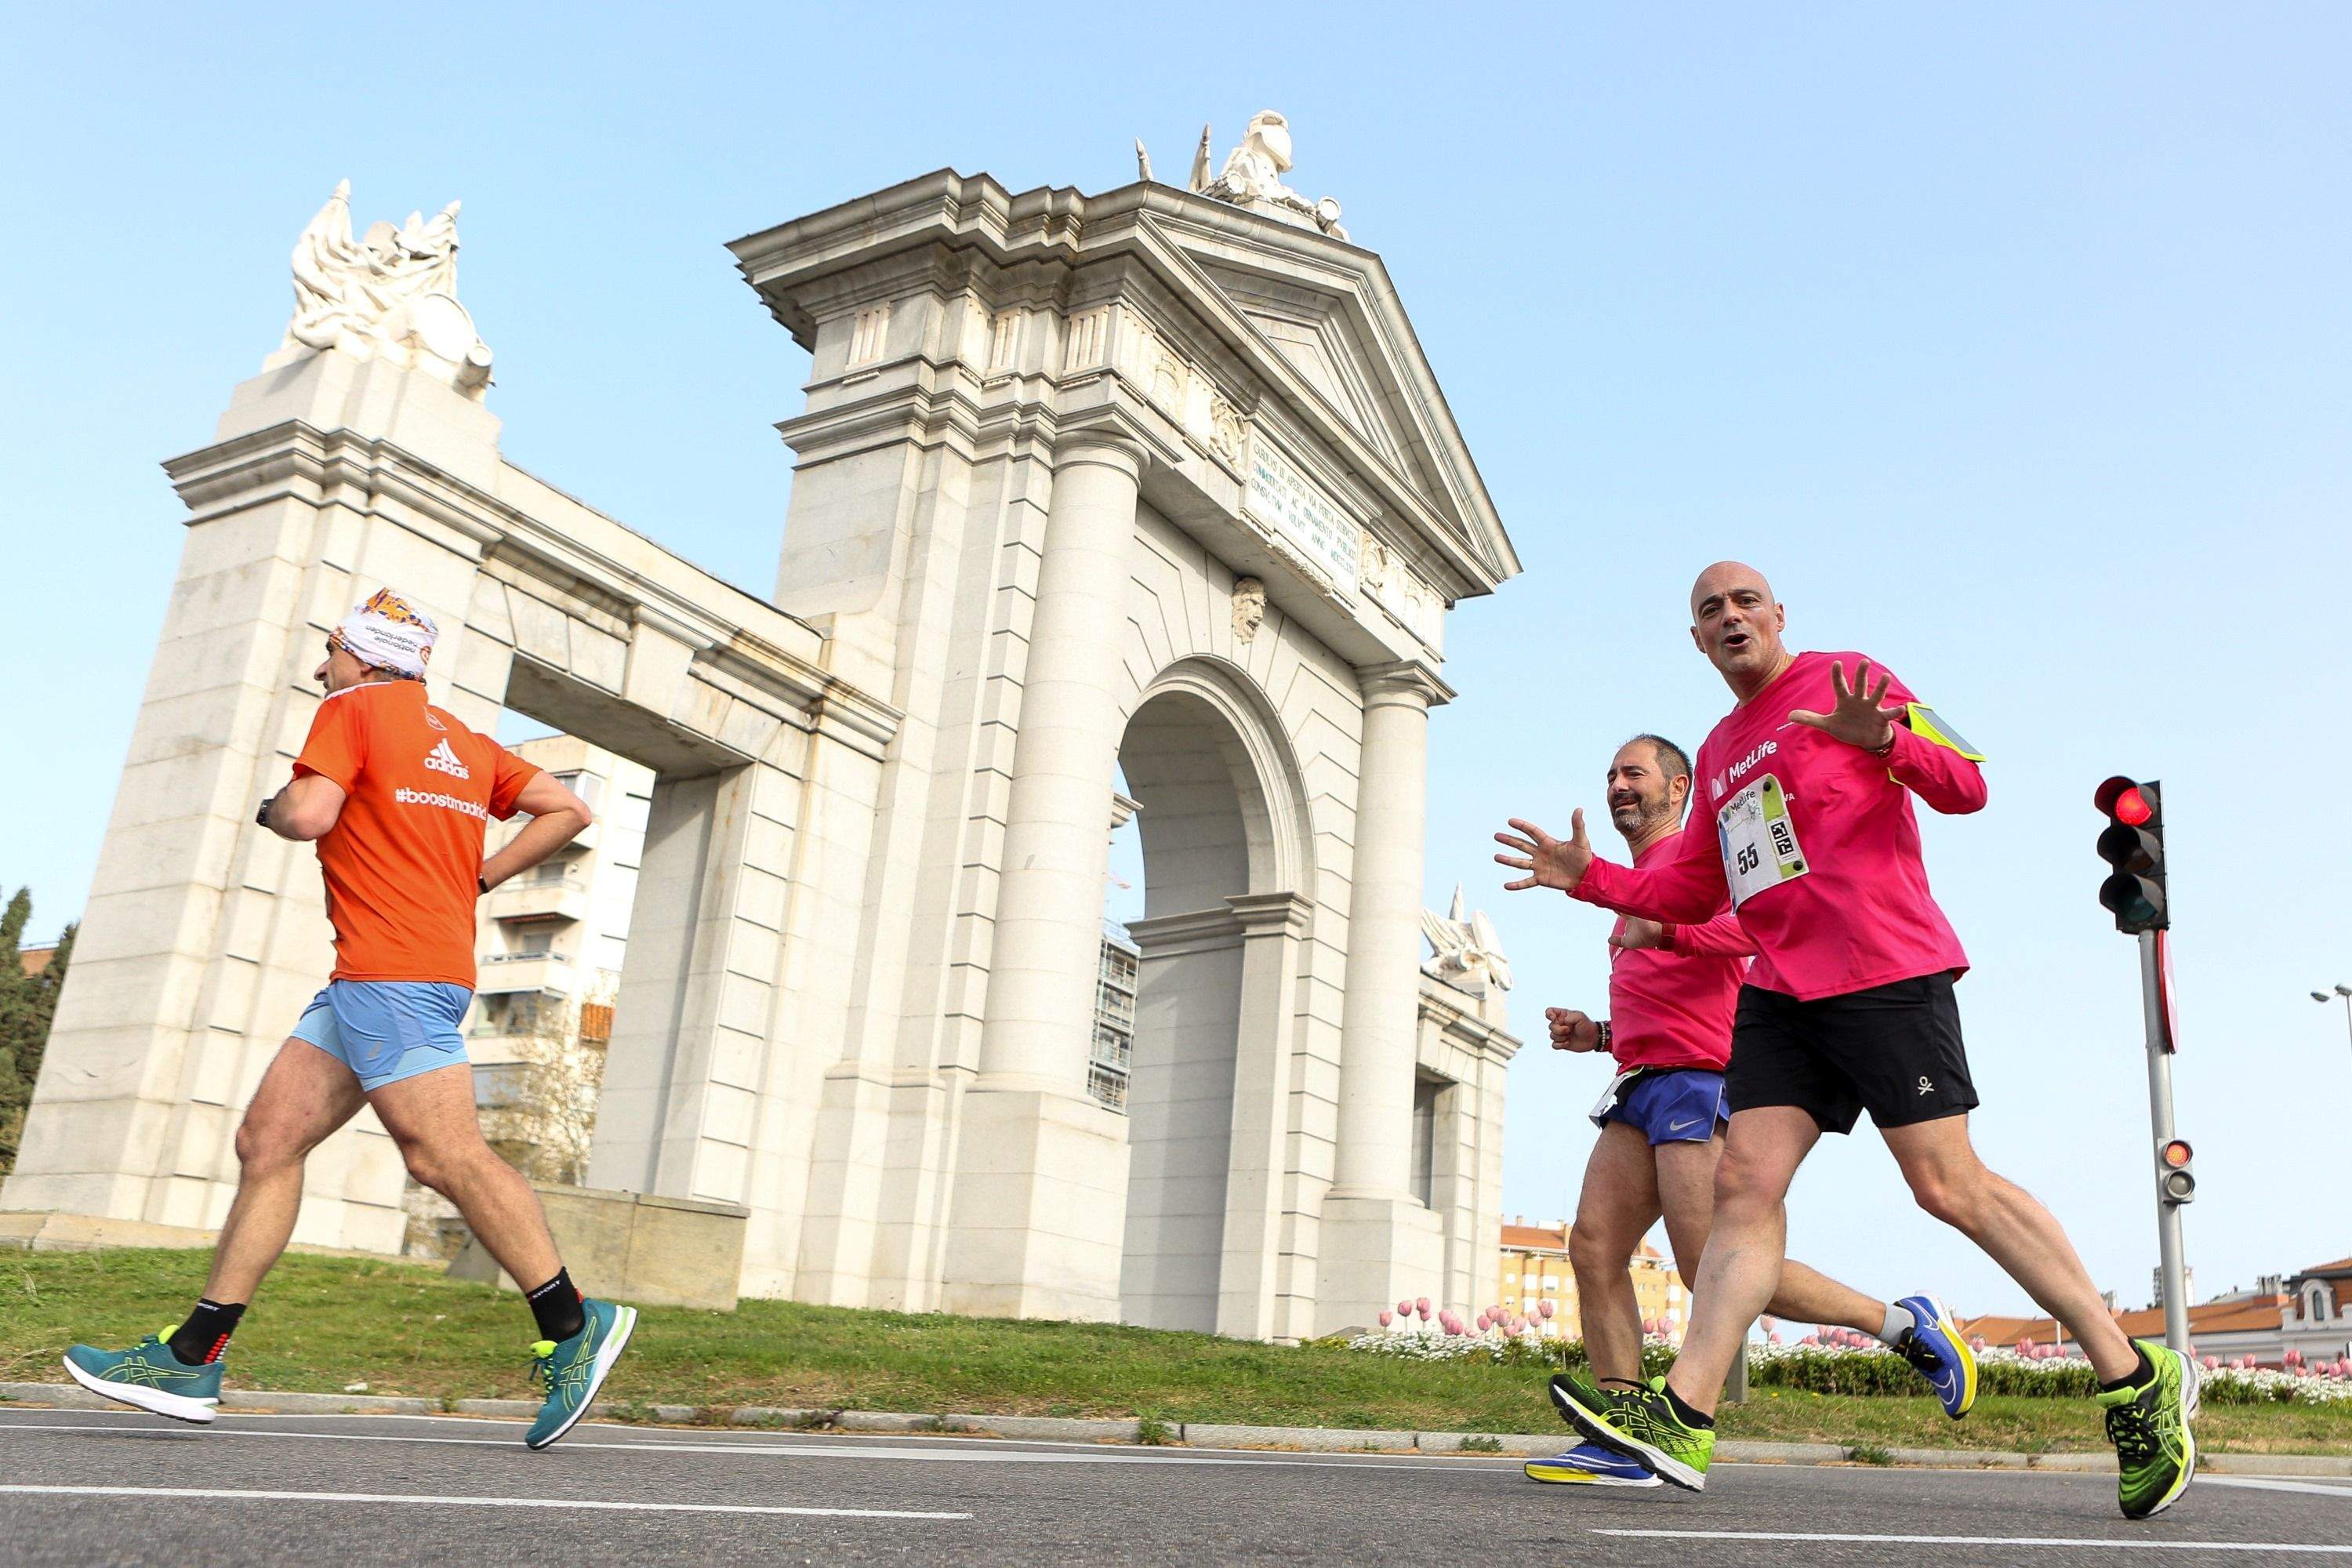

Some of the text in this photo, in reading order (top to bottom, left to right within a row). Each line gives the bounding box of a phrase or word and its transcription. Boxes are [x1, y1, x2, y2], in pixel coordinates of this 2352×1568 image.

[374, 636, 416, 653] nationale
[424, 757, 470, 780] adidas
[1729, 740, 1777, 784] MetLife
[1730, 790, 1755, 814] MetLife
[1737, 842, 1759, 876] 55
